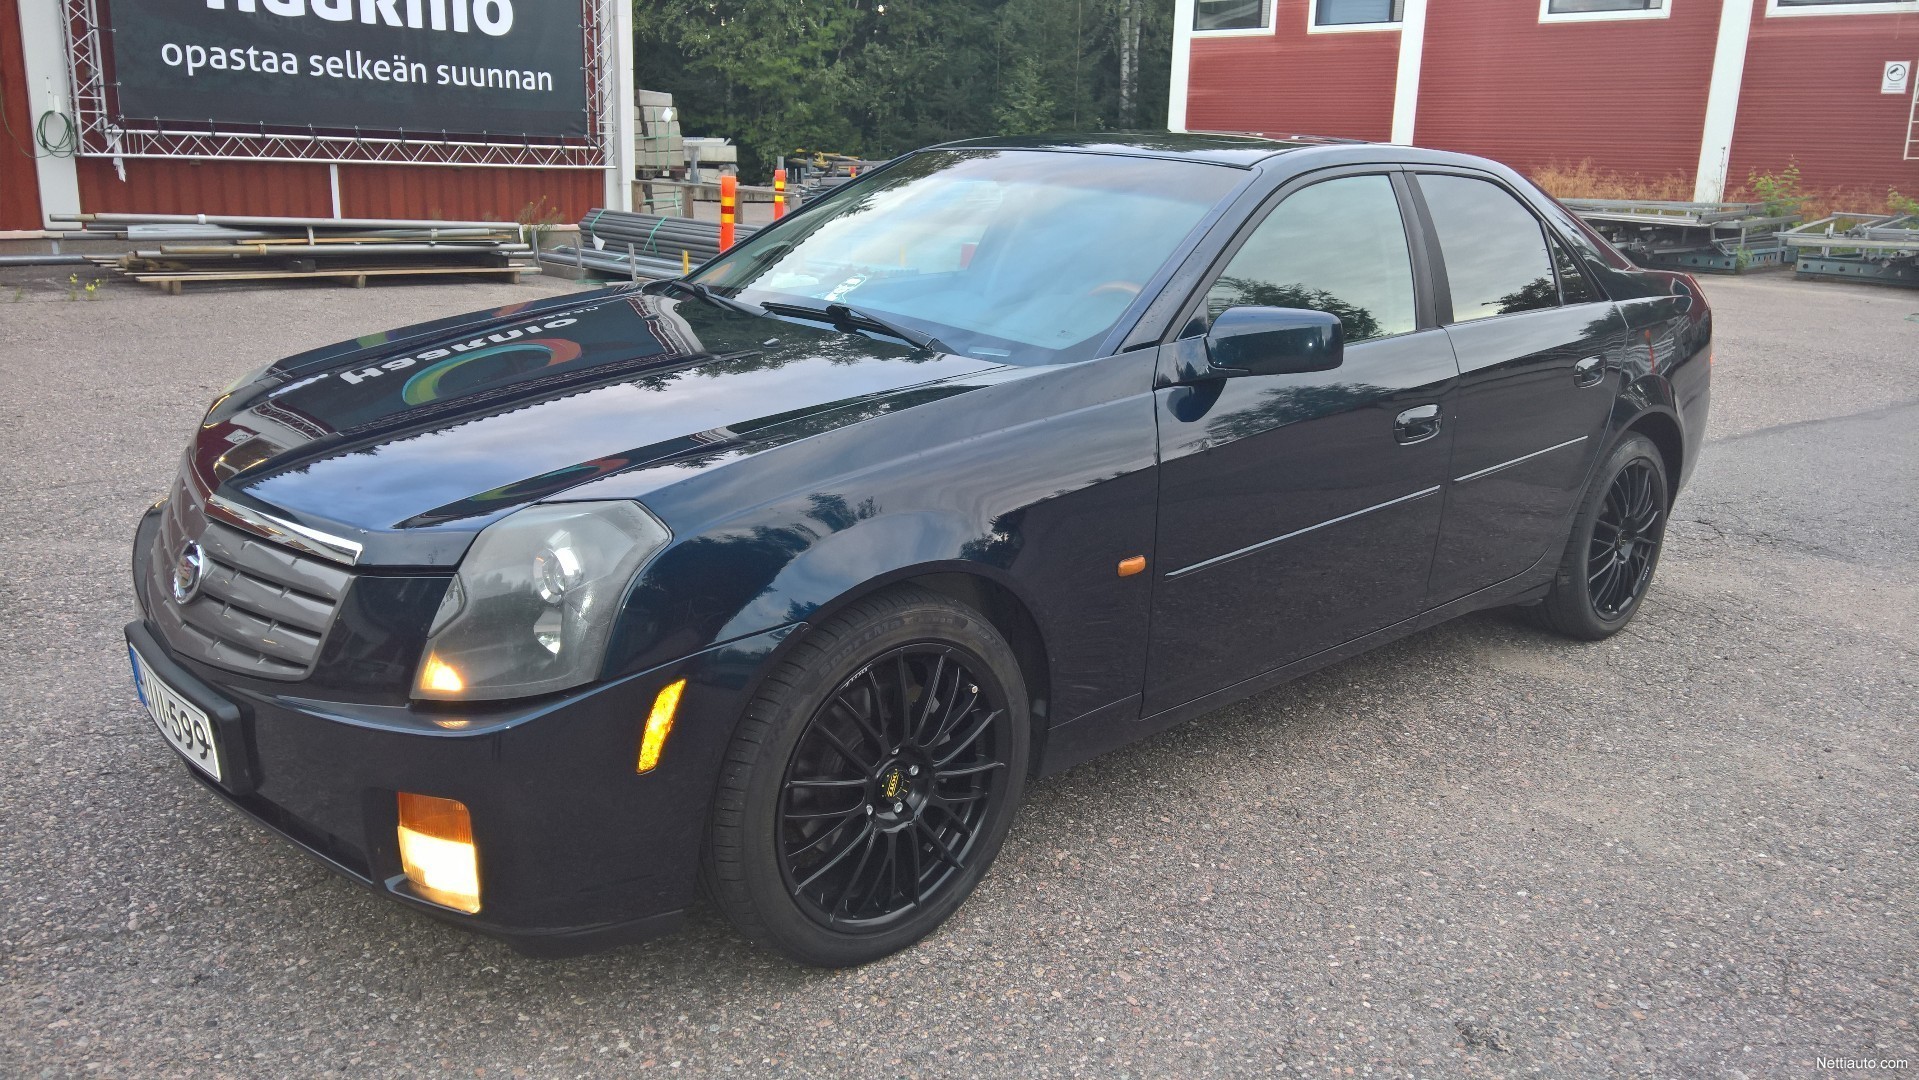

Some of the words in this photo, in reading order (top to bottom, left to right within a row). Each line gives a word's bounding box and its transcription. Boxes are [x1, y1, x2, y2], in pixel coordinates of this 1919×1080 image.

[161, 43, 299, 77] opastaa
[309, 50, 428, 84] selkeän
[436, 64, 553, 92] suunnan
